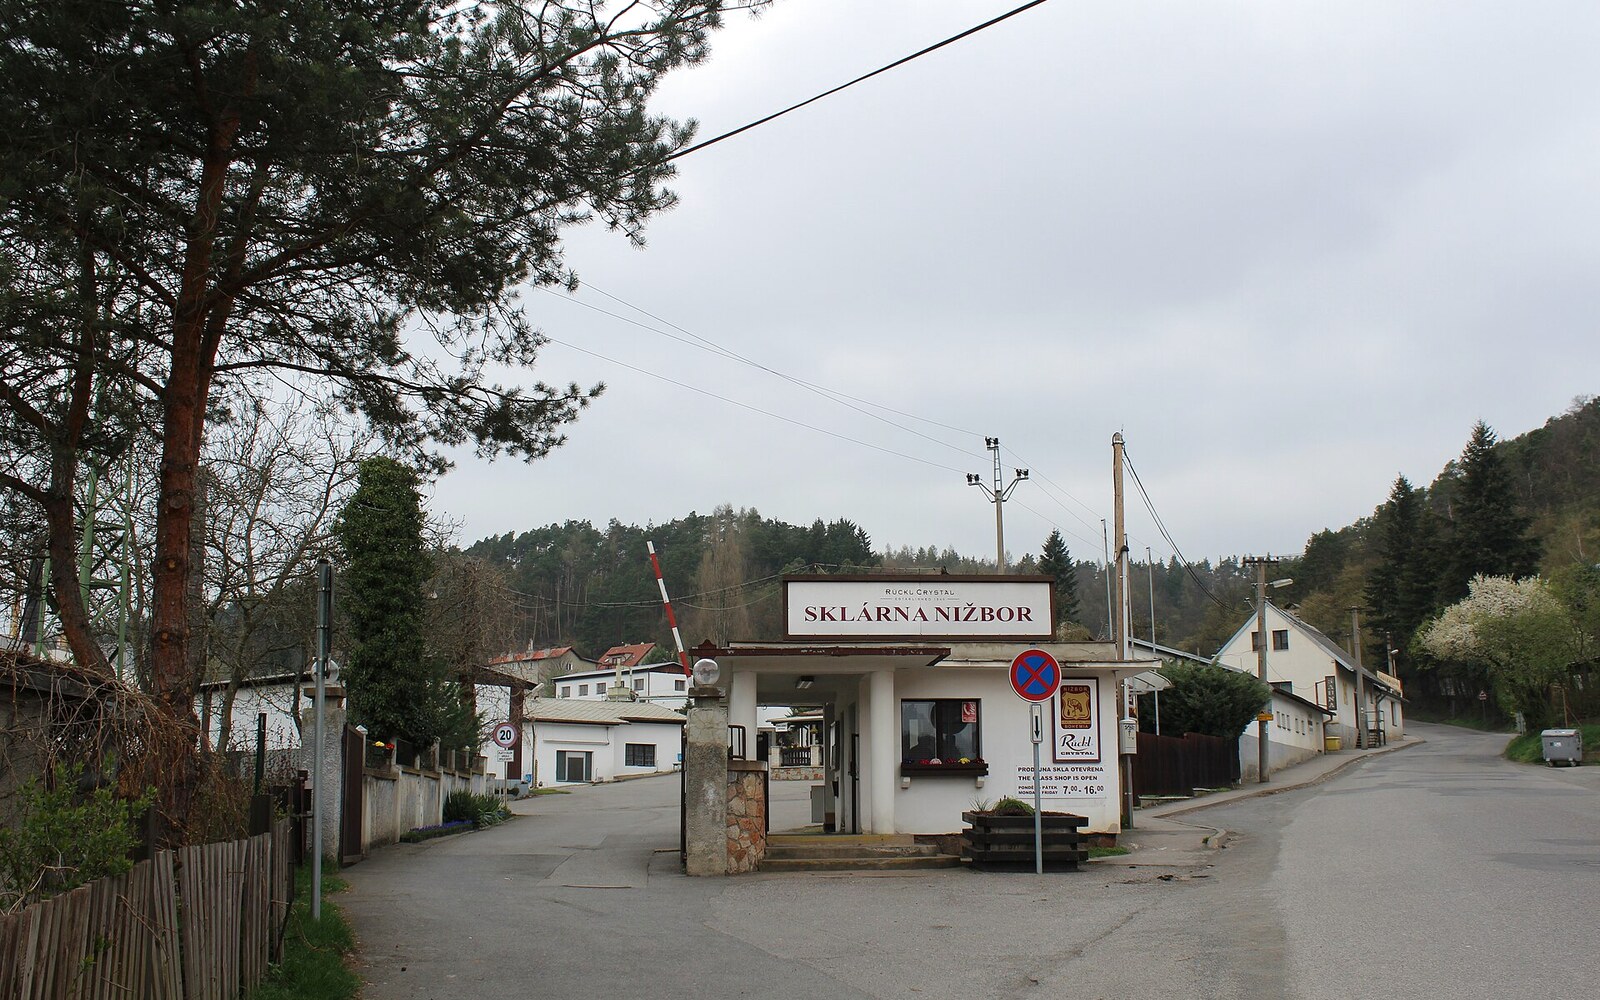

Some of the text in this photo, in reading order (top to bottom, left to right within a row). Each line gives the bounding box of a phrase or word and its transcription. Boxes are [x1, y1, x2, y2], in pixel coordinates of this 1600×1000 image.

[804, 602, 1033, 622] SKLÁRNA NIŽBOR
[500, 730, 511, 740] 20
[1084, 786, 1104, 794] 16.00
